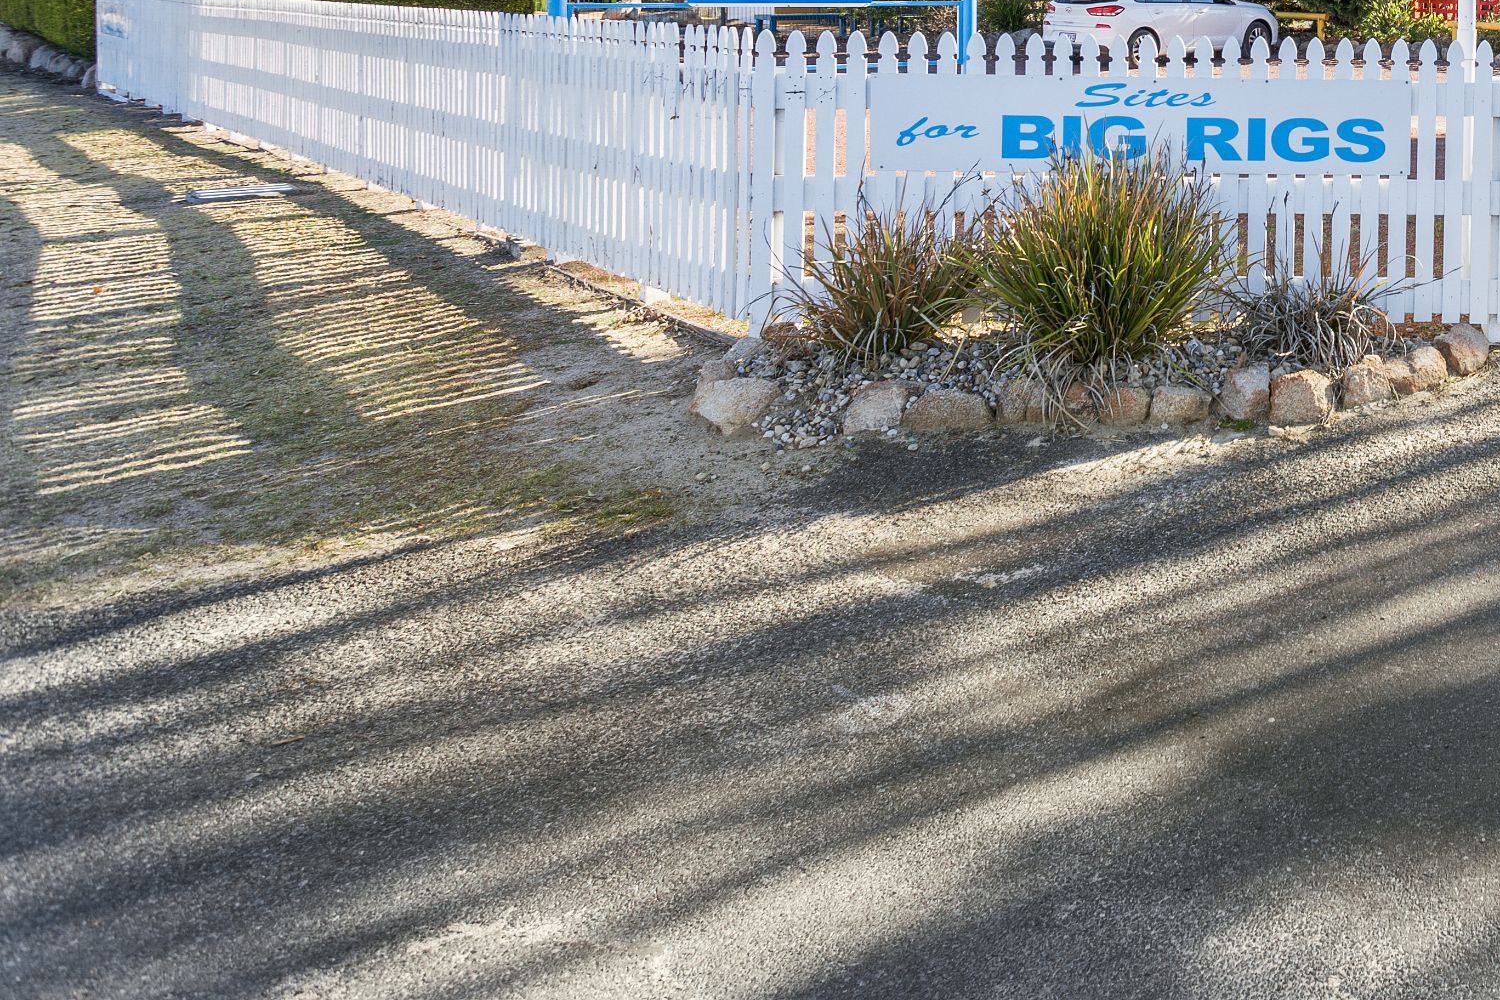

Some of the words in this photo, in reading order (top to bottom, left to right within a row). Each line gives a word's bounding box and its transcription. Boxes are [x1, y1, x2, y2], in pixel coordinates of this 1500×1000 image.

[1074, 82, 1217, 108] Sites
[896, 116, 980, 147] for
[1001, 114, 1147, 160] BIG
[1186, 116, 1386, 163] RIGS
